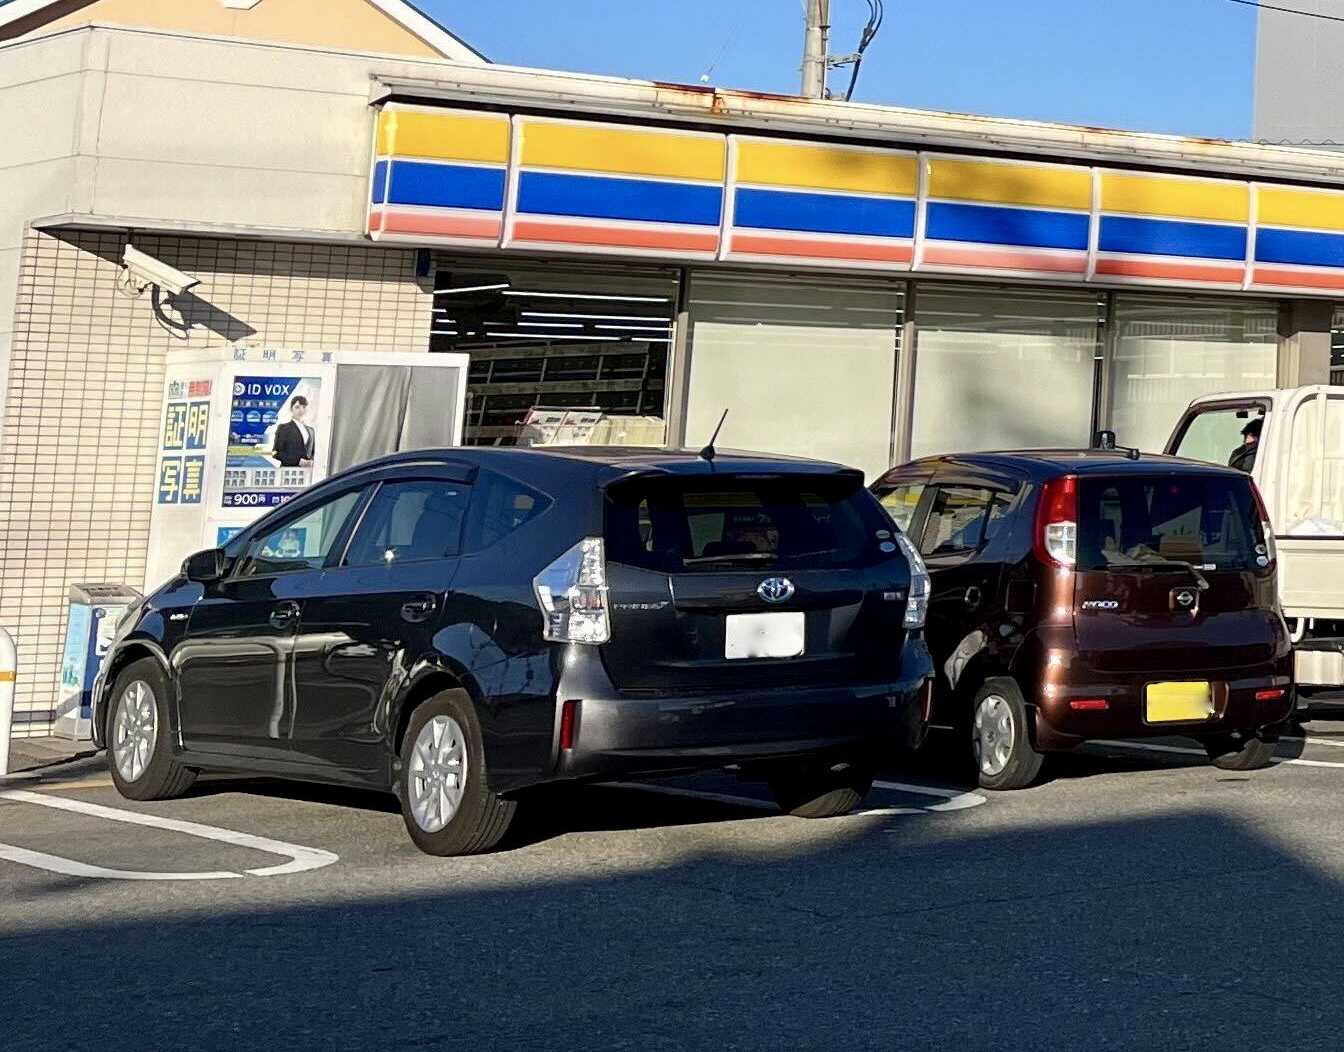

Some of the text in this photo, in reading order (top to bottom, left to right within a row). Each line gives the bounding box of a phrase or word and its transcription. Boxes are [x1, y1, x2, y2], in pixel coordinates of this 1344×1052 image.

[247, 384, 290, 396] ID VOX
[165, 404, 210, 448] 証明
[160, 459, 203, 502] 写真
